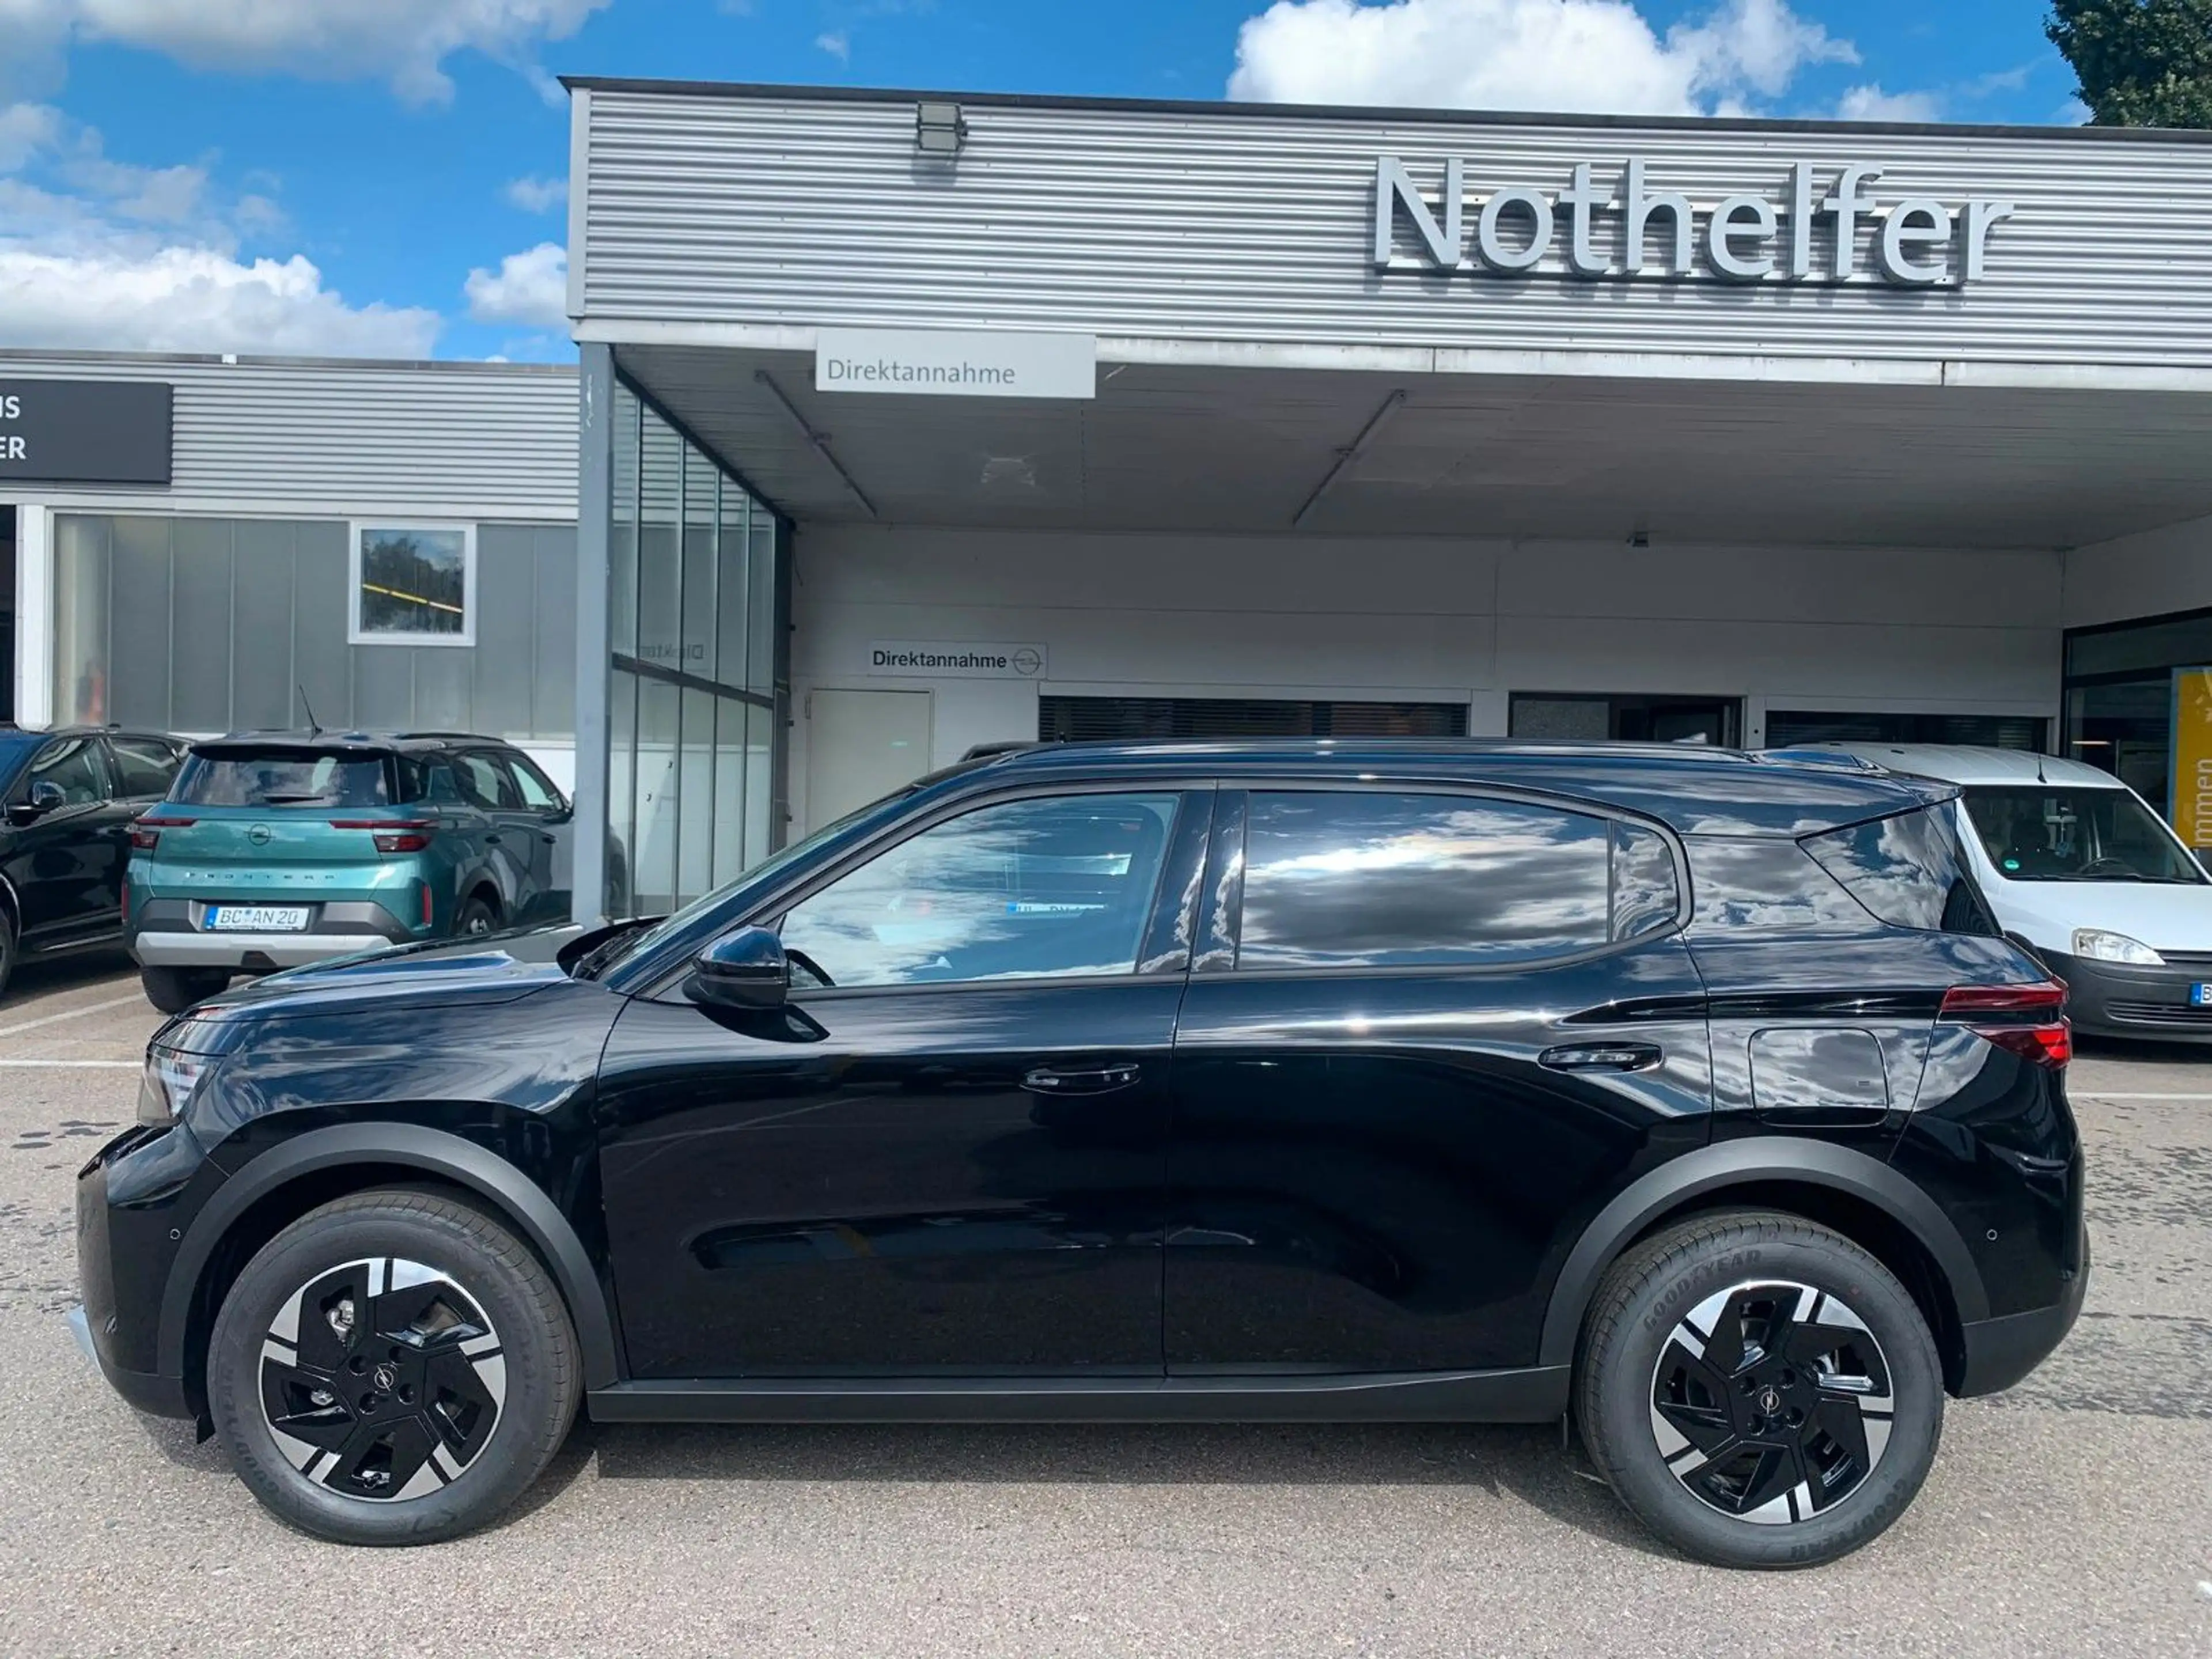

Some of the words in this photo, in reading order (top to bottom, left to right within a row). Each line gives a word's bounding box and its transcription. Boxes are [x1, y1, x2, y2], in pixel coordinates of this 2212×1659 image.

[1373, 156, 2015, 283] Nothelfer
[827, 359, 1016, 384] Direktannahme
[0, 395, 21, 419] S
[873, 650, 1007, 668] Direktannahme
[221, 909, 243, 923] BC
[252, 910, 275, 924] AN
[276, 910, 298, 925] 20
